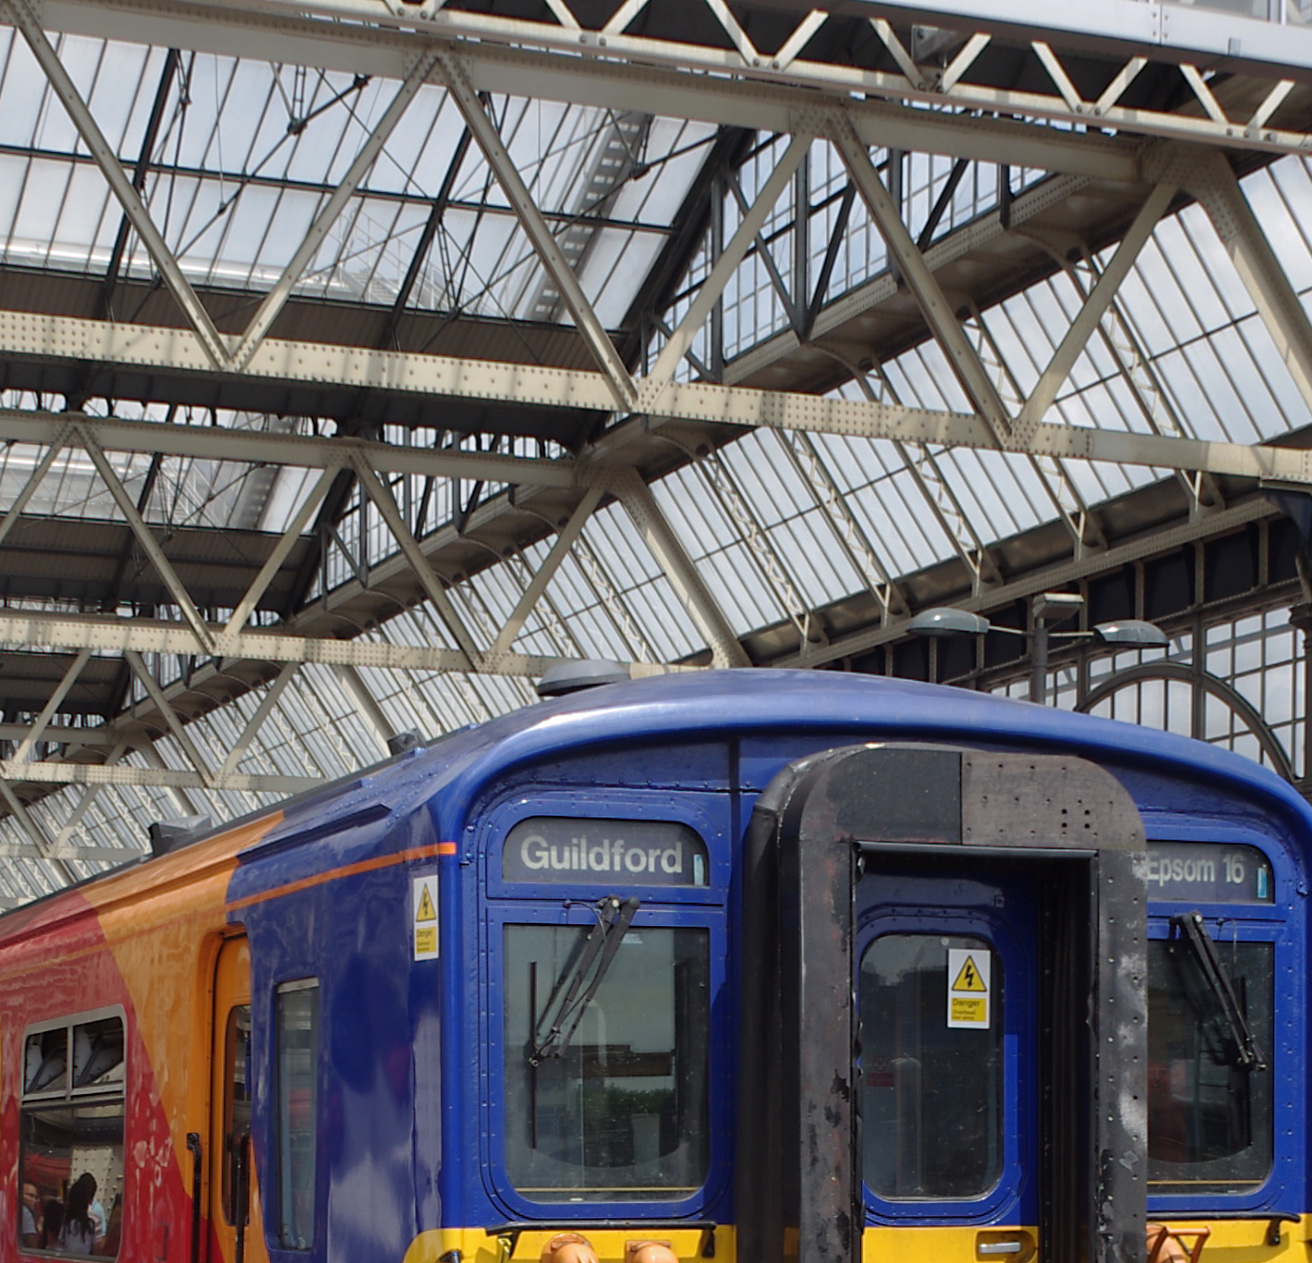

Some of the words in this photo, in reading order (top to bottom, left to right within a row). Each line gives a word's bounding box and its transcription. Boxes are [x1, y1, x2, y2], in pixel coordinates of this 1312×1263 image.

[520, 834, 683, 874] Guildford
[1146, 851, 1215, 887] Epsom
[1223, 853, 1246, 884] 16
